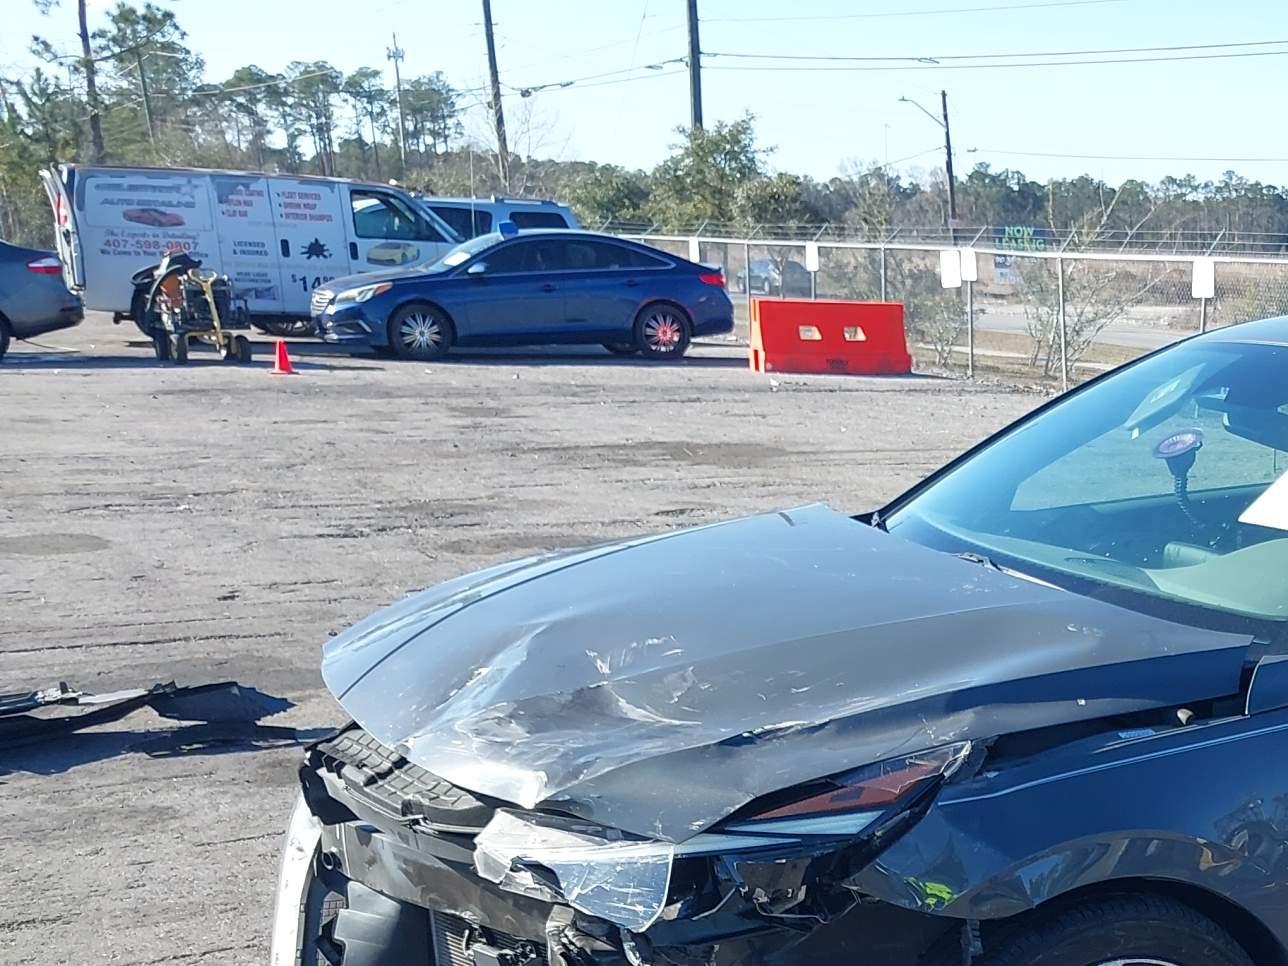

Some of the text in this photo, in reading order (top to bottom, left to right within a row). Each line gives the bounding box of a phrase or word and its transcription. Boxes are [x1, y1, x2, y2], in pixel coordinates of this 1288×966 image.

[1005, 226, 1034, 237] NOW
[233, 240, 265, 248] LICENSED
[995, 238, 1045, 250] LEASING
